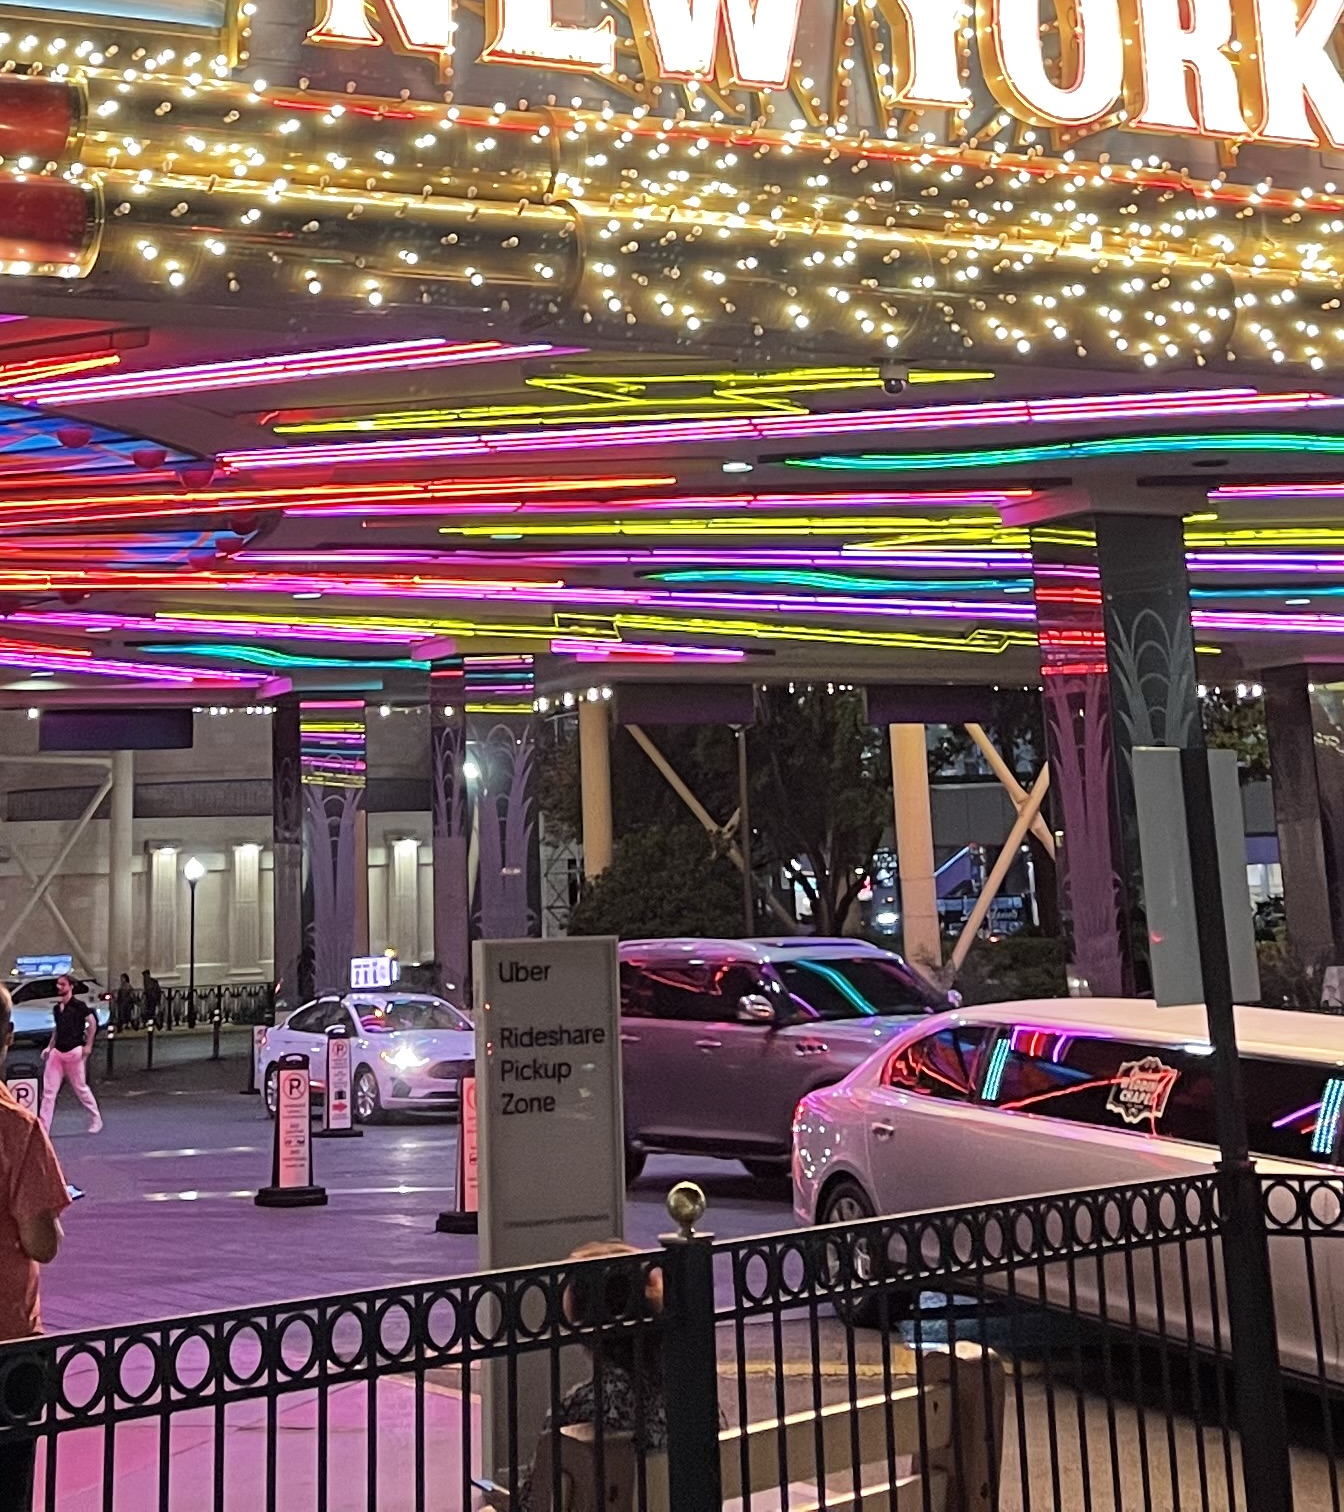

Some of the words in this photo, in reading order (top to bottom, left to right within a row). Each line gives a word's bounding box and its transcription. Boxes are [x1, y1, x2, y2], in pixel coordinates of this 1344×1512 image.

[498, 960, 553, 984] Uber
[499, 1025, 606, 1050] Rideshare
[500, 1059, 573, 1083] Pickup
[501, 1093, 557, 1116] Zone
